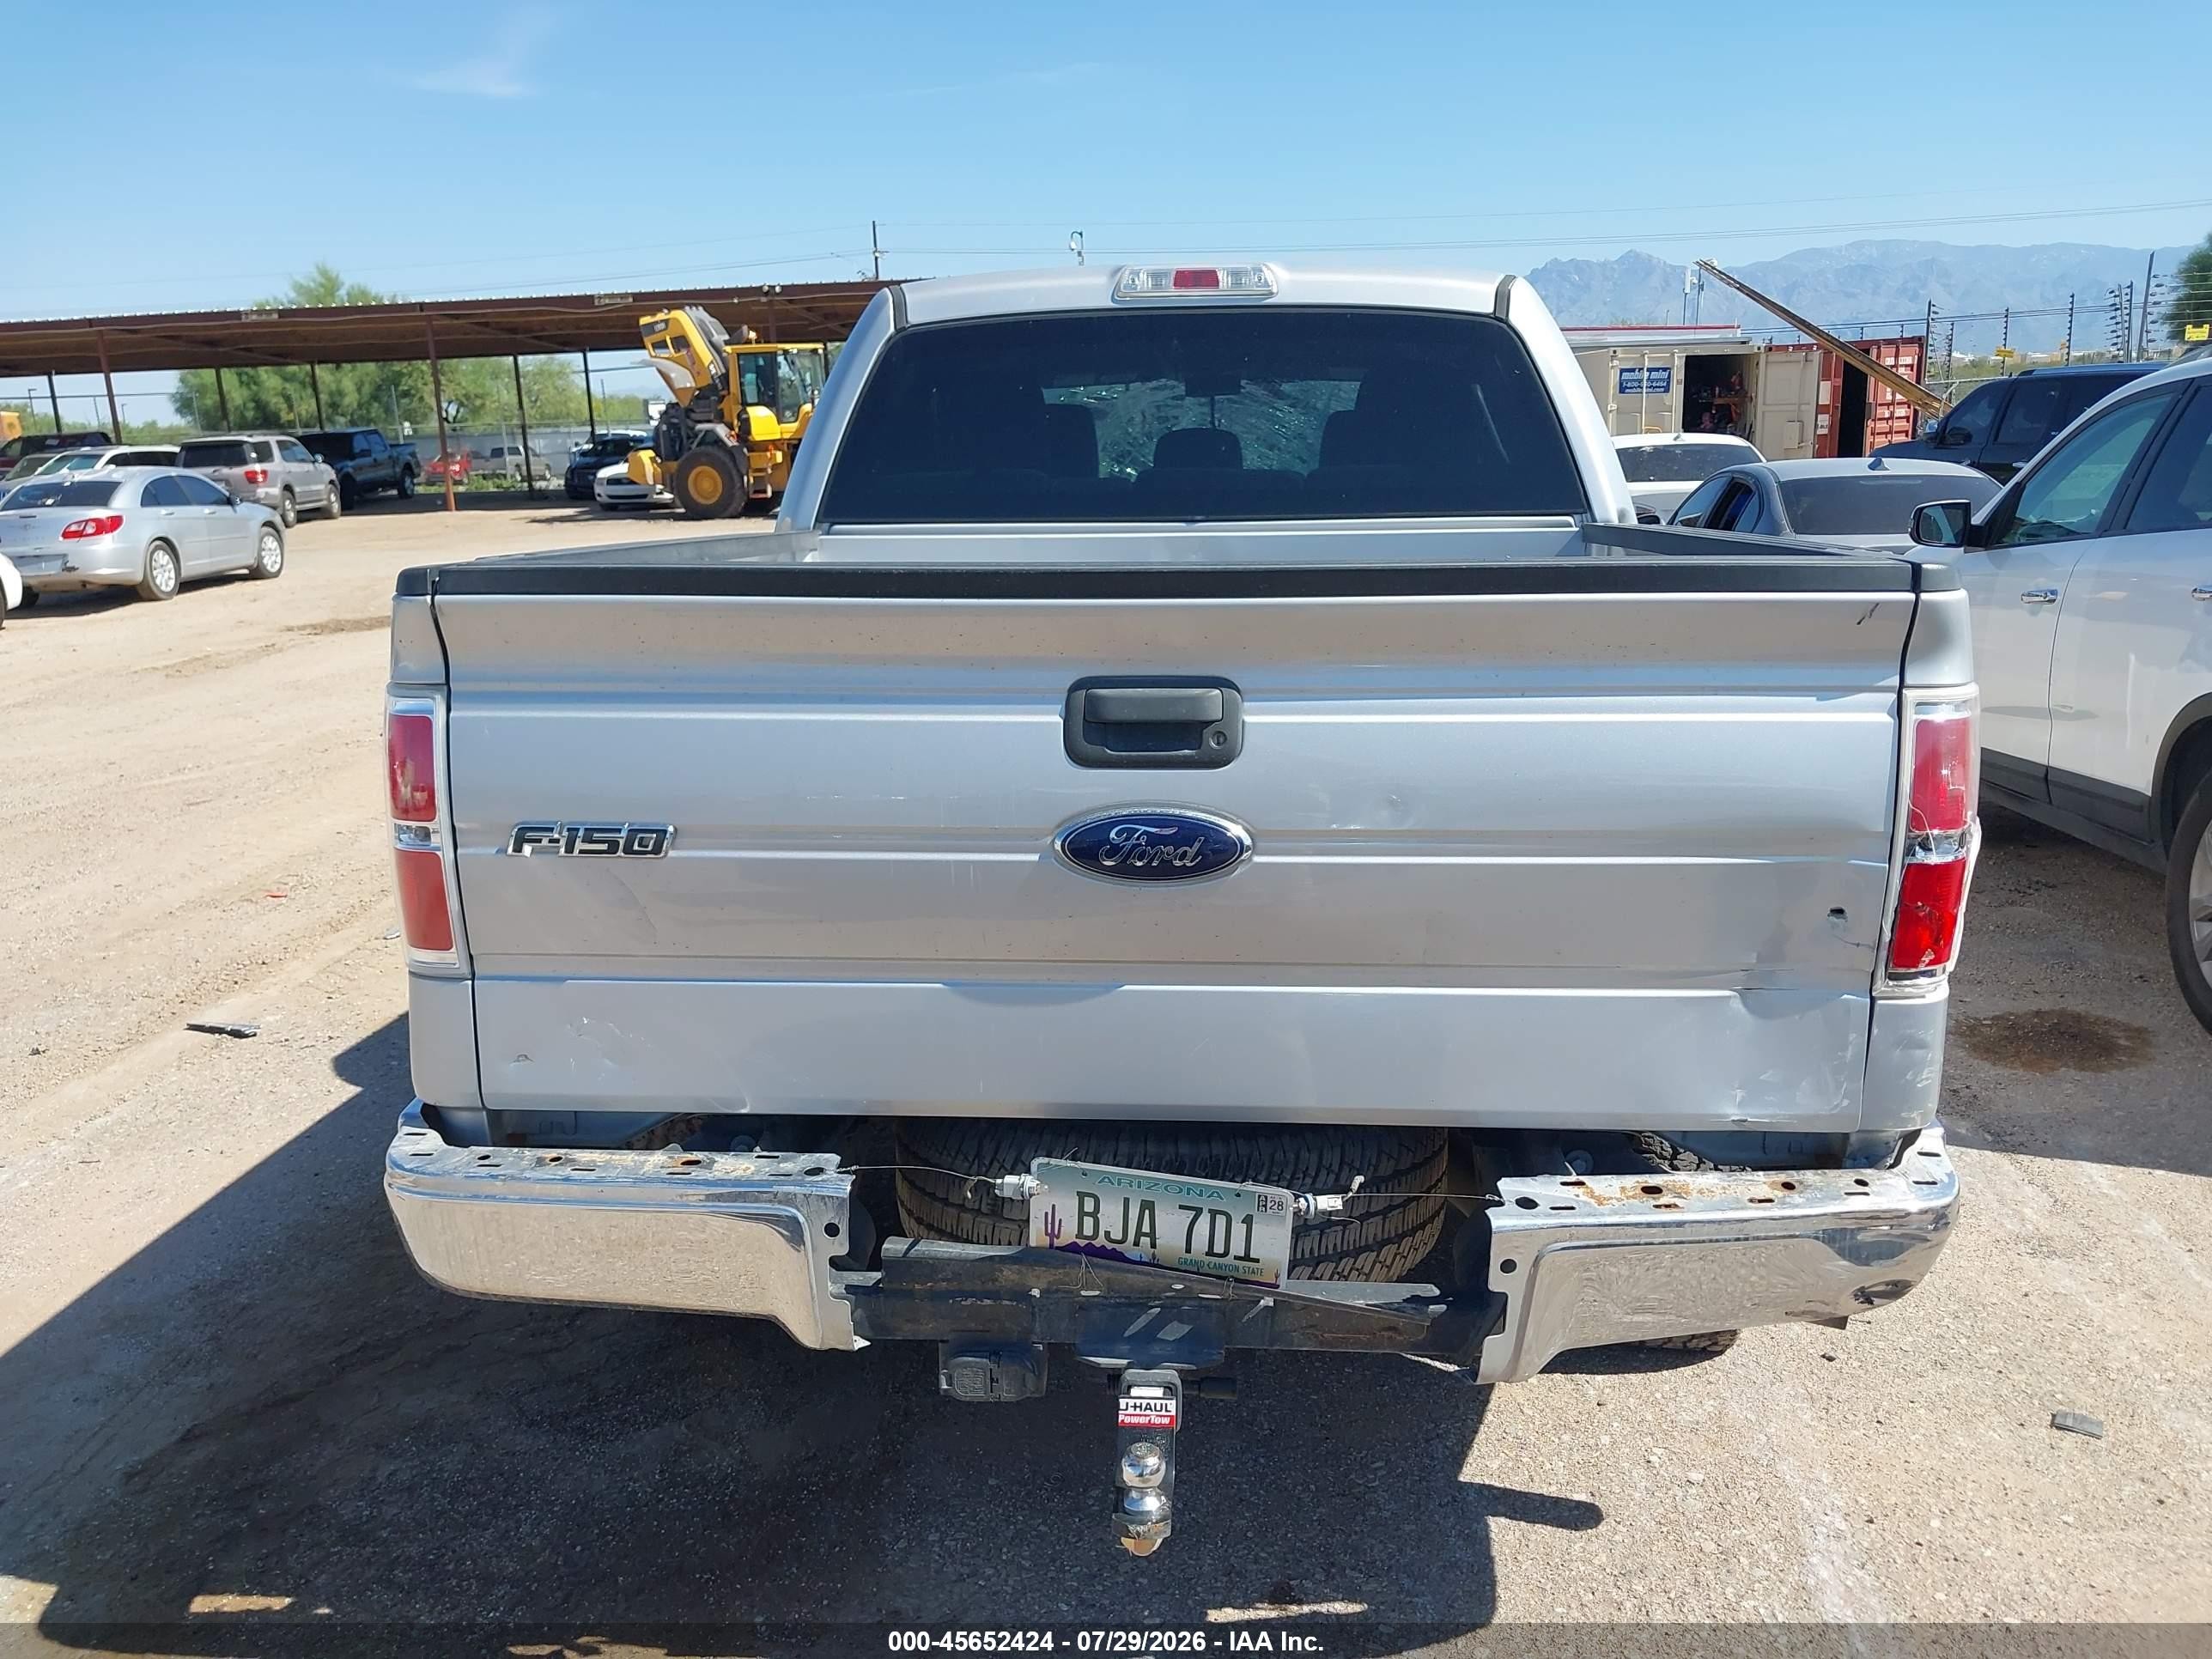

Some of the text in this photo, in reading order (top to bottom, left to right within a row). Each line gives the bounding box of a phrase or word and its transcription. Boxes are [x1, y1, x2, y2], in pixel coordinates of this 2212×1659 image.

[1650, 370, 1669, 379] mini
[509, 823, 675, 857] F-150
[1098, 823, 1206, 867] Ford
[1097, 1175, 1224, 1200] ARIZONA
[1269, 1200, 1284, 1212] 28
[1075, 1190, 1261, 1264] BJA 7D1
[1177, 1256, 1264, 1277] GRAND CANYON STATE
[1119, 1414, 1170, 1425] PowerTow
